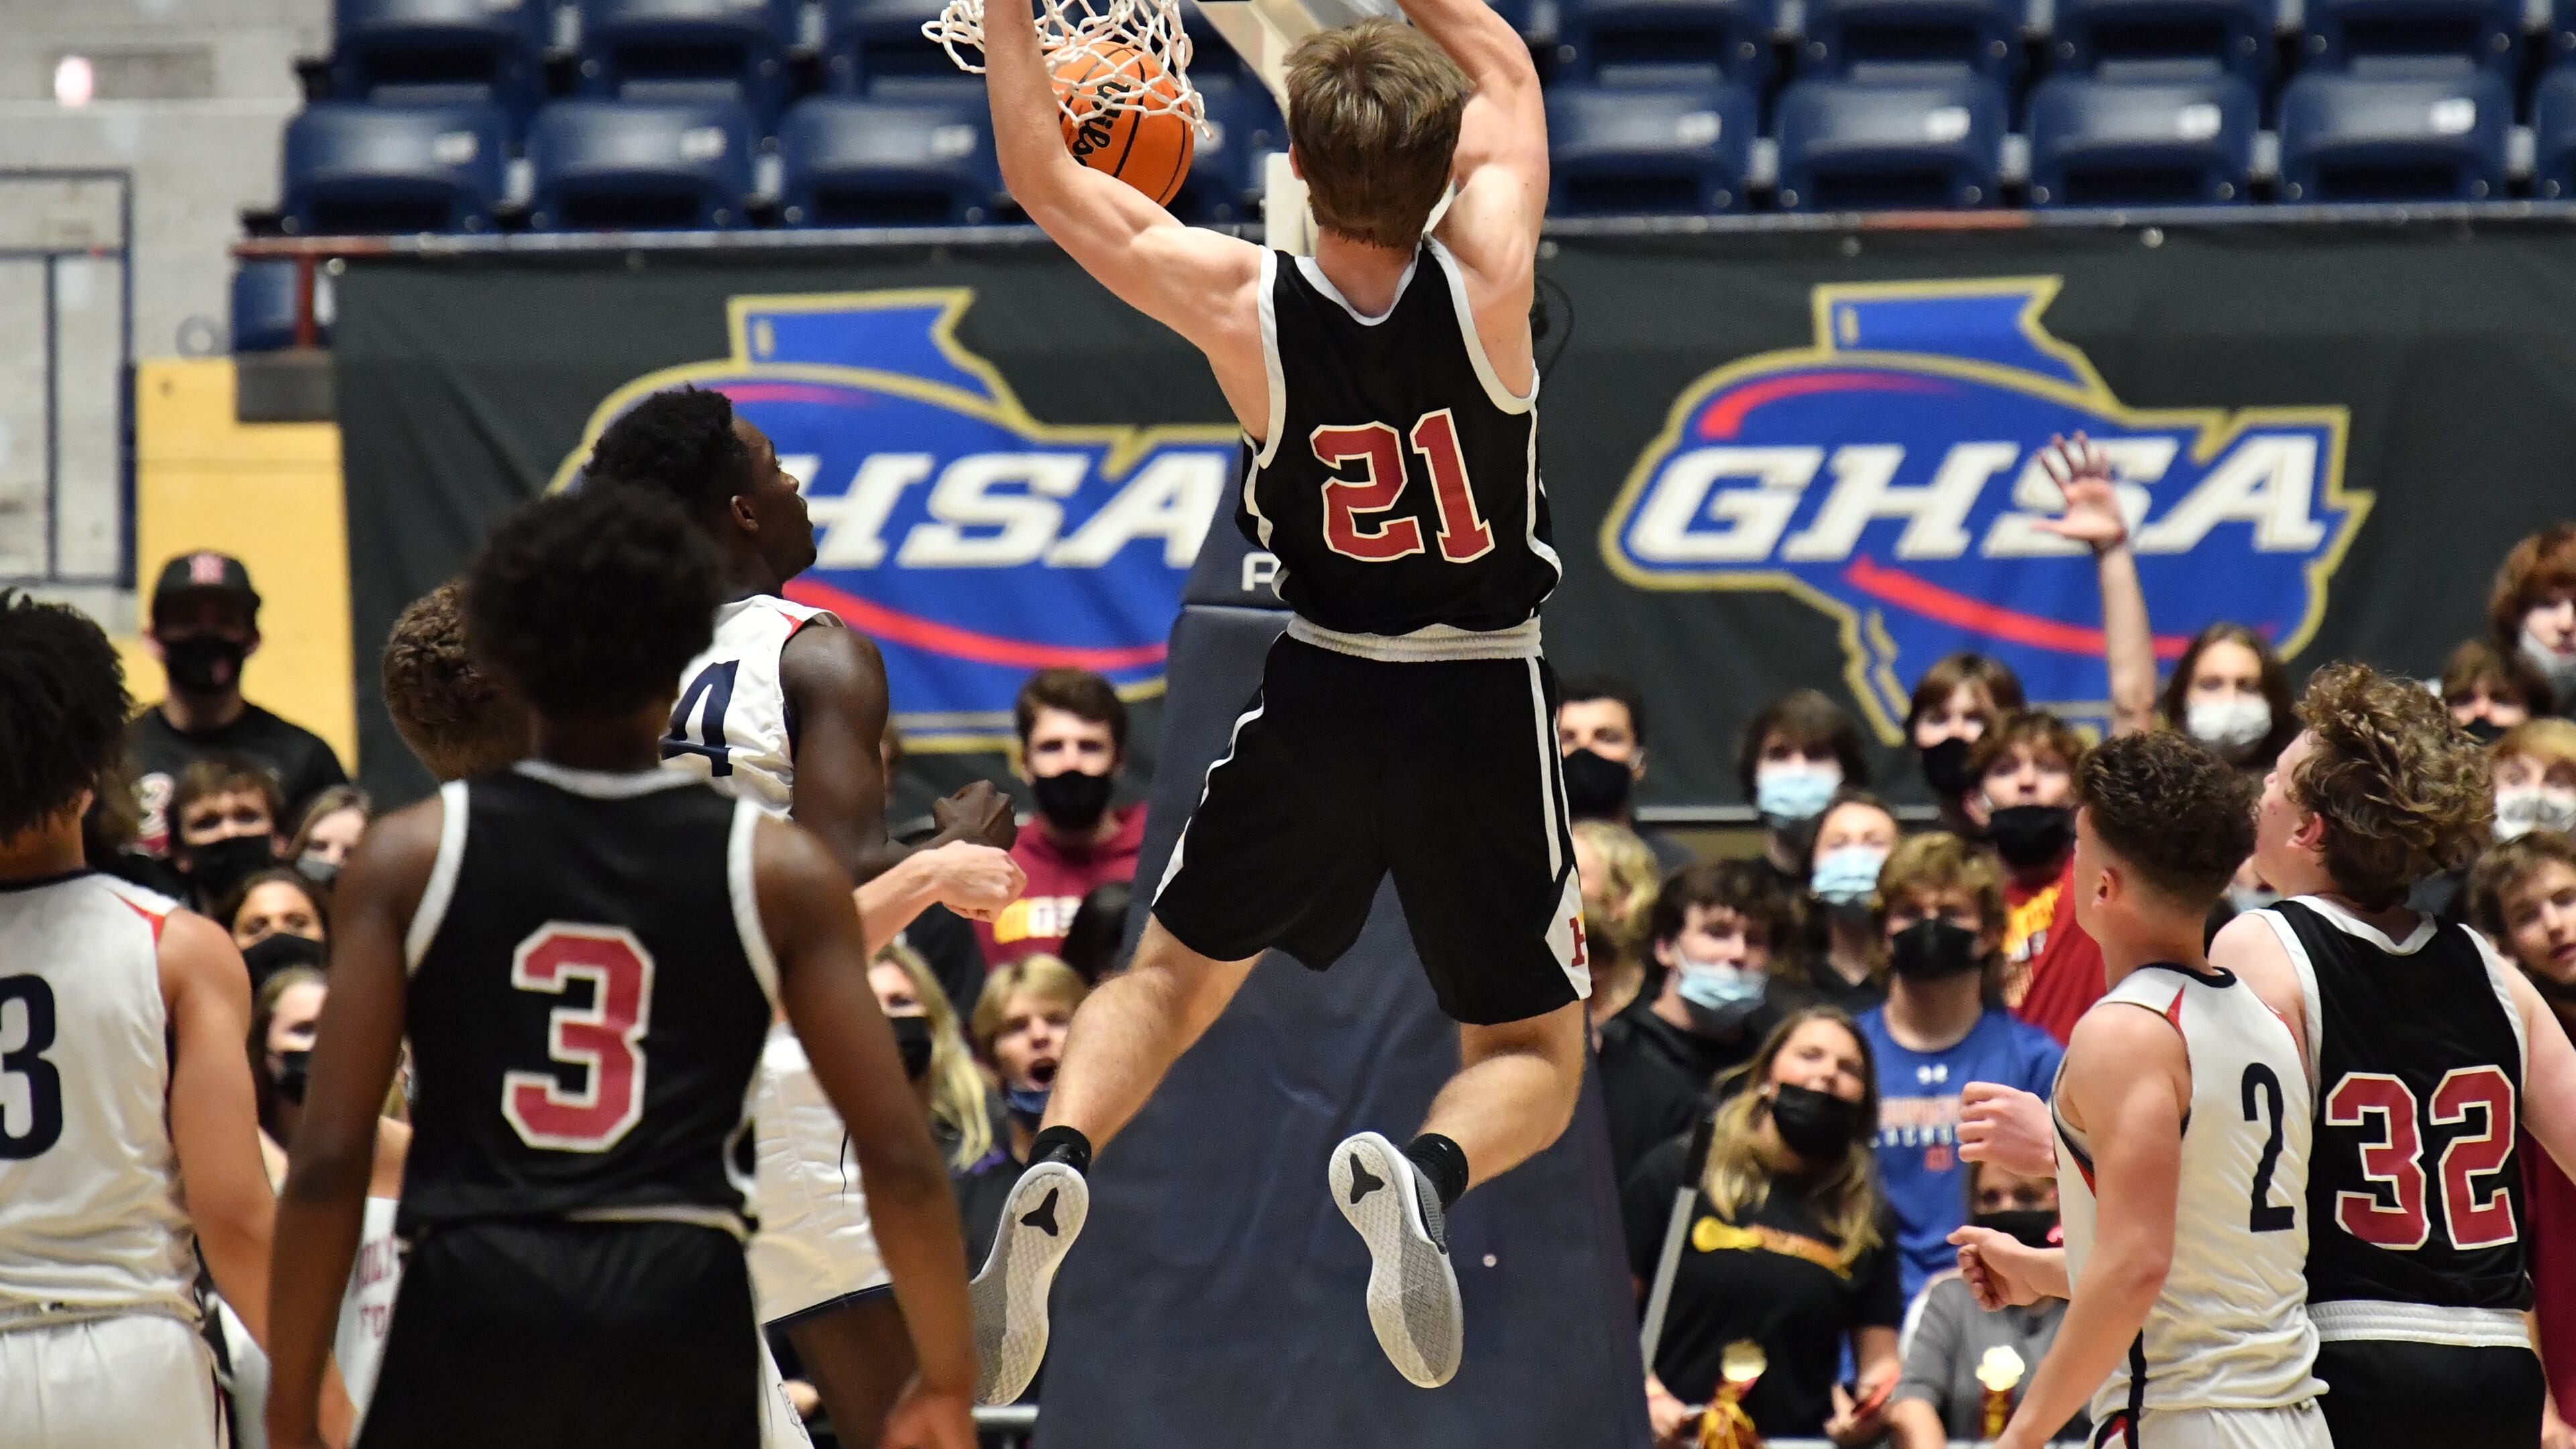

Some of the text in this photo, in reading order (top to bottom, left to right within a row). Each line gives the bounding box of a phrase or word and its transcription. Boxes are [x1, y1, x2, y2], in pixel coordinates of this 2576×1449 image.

[797, 453, 1229, 570] HSA
[1310, 407, 1495, 563] 21
[1627, 435, 2325, 562] GHSA
[657, 659, 740, 777] 4
[0, 973, 62, 1159] 3
[502, 920, 655, 1152] 3
[2241, 1063, 2295, 1233] 2
[2326, 1064, 2518, 1251] 32
